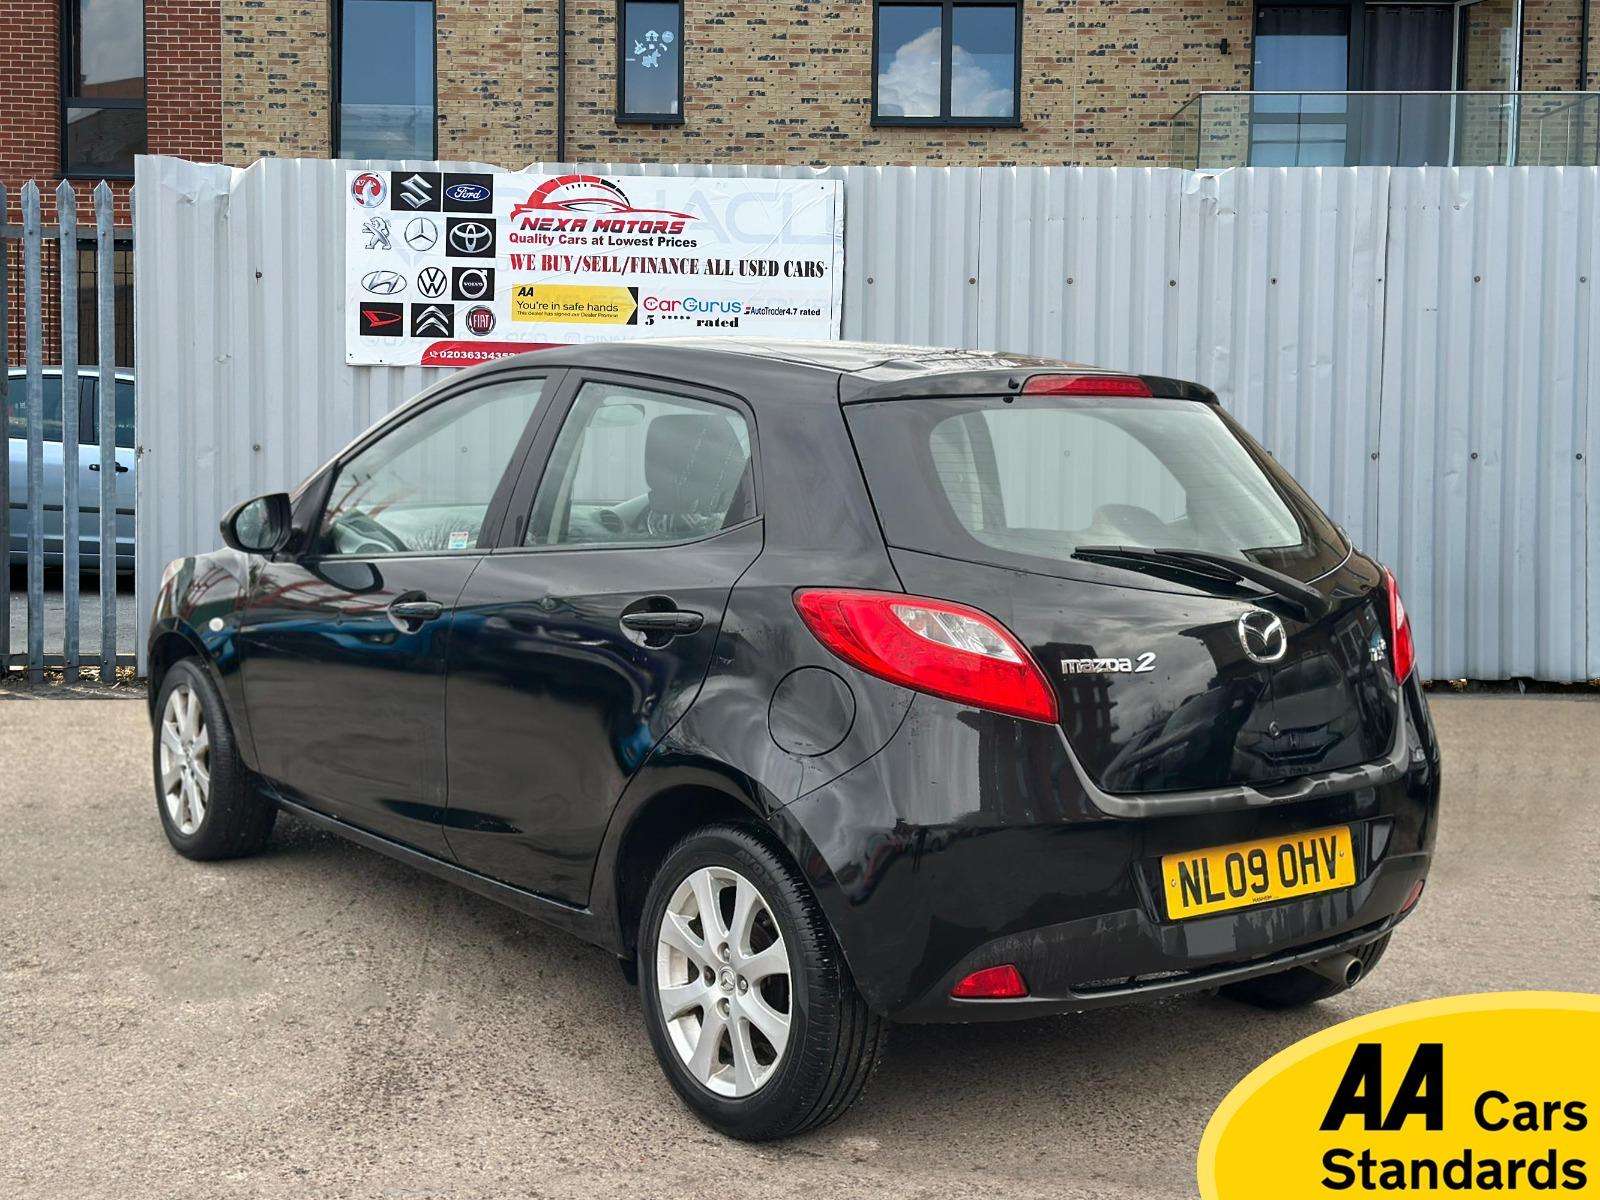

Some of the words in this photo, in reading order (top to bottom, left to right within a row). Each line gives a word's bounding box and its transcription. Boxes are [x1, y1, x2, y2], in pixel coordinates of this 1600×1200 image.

[454, 186, 481, 199] Ford
[520, 217, 587, 232] NEXA
[592, 219, 685, 234] MOTORS
[509, 232, 555, 246] Quality
[558, 234, 588, 245] Cars
[591, 235, 604, 245] at
[608, 235, 653, 246] Lowest
[657, 236, 697, 247] Prices
[510, 253, 536, 271] WE
[703, 258, 734, 276] ALL
[738, 259, 779, 277] USED
[783, 260, 825, 278] CARS
[517, 286, 534, 297] AA
[516, 300, 549, 310] You're
[551, 301, 560, 310] in
[563, 302, 582, 311] safe
[587, 302, 619, 312] hands
[643, 296, 742, 313] CarGurus
[799, 308, 821, 316] rated
[473, 314, 490, 328] FIAT
[696, 317, 739, 327] rated
[1134, 652, 1156, 673] 2
[1178, 849, 1270, 908] NL09
[1277, 835, 1337, 888] OHV
